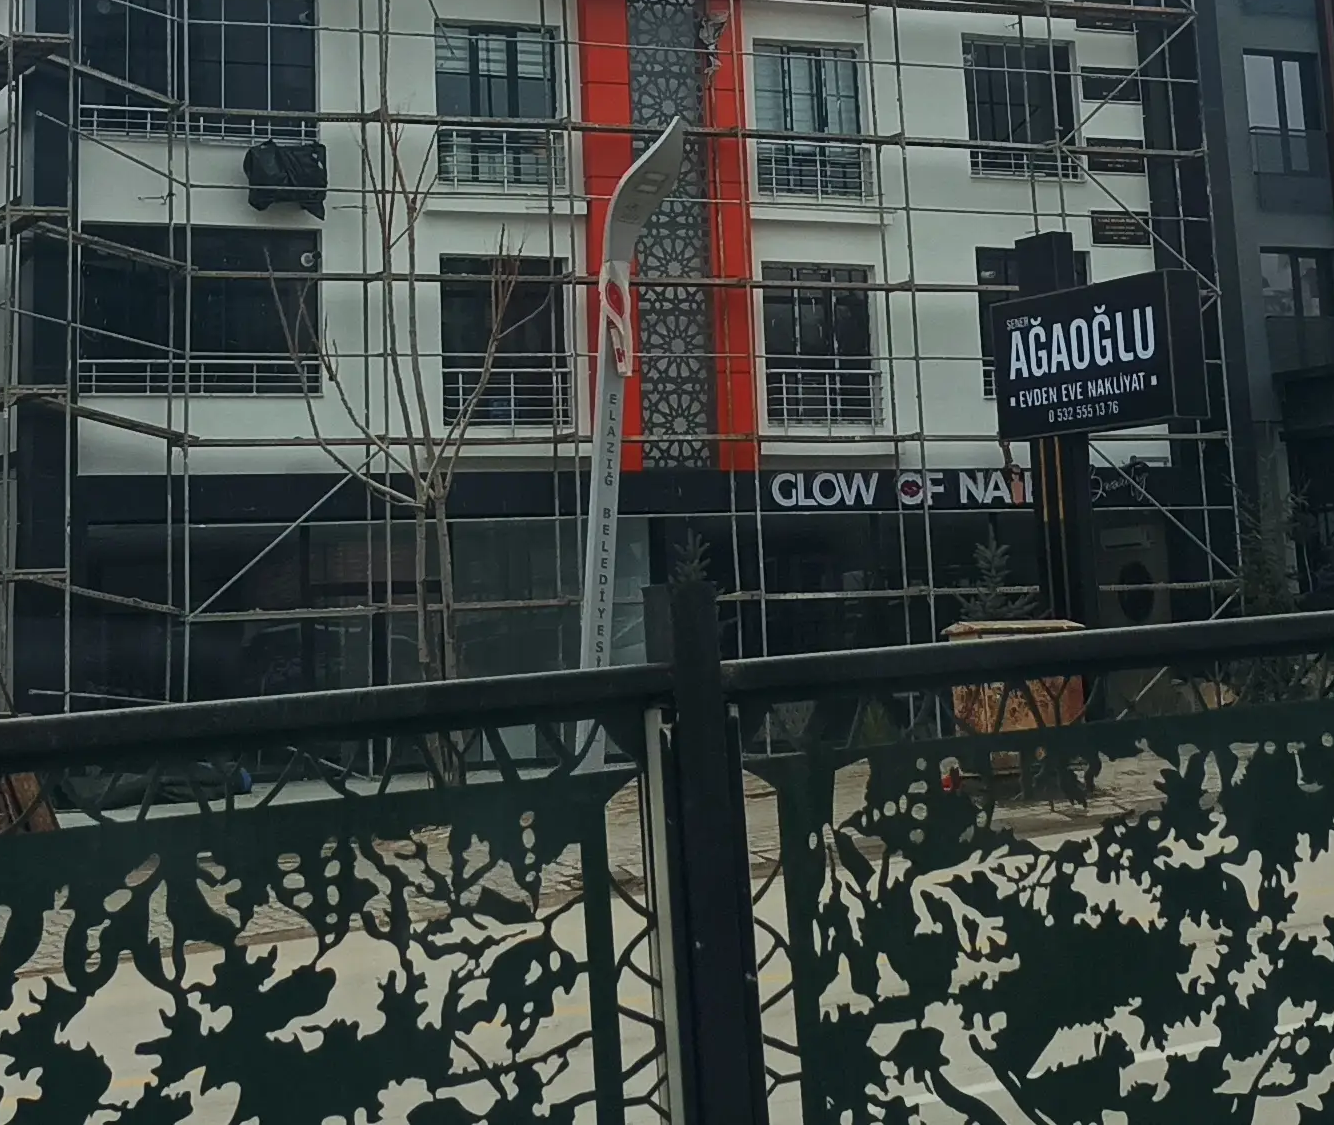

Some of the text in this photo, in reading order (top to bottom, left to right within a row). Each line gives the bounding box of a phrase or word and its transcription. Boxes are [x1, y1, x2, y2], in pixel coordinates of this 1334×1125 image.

[1009, 304, 1155, 379] AĞAOĞLU
[1019, 372, 1145, 408] EVDEN EVE NAKLİYAT
[1048, 400, 1119, 422] 0 532 555 13 76
[604, 393, 617, 487] ELAZIĞ
[771, 472, 879, 506] GLOW
[898, 472, 944, 505] OF
